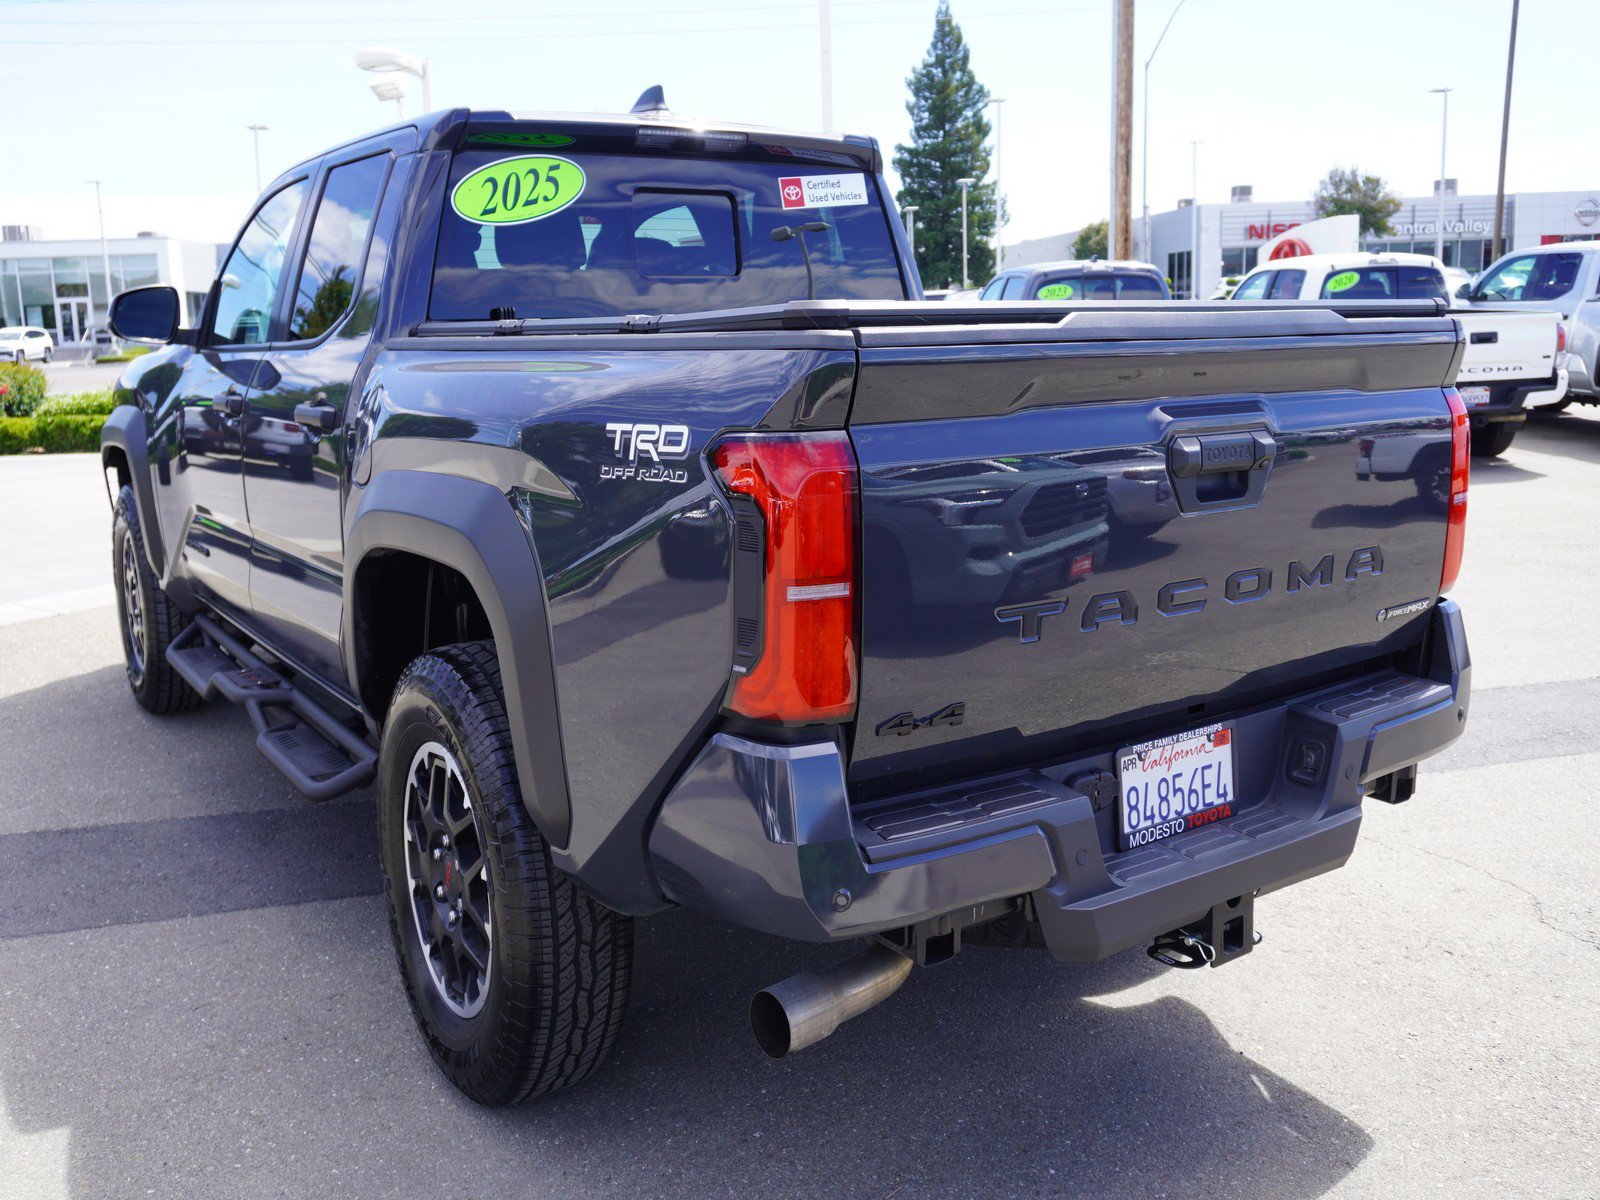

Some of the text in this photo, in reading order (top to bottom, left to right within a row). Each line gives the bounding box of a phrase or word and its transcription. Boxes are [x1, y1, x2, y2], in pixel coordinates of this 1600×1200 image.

[480, 163, 561, 216] 2025
[807, 178, 841, 190] Certified
[809, 191, 862, 203] Used Vehicles
[1390, 219, 1491, 236] entral Valley
[1044, 286, 1068, 299] 2023
[1332, 271, 1355, 290] 2020
[605, 422, 690, 463] TRD
[1203, 444, 1253, 463] TOYOTA
[599, 464, 688, 484] OFF ROAD
[994, 544, 1385, 645] TACOMA
[874, 701, 965, 737] 4x4
[1132, 723, 1223, 754] PRICE FAMILY DEALERSHIPS
[1121, 757, 1137, 773] APR
[1141, 741, 1214, 773] California
[1126, 760, 1229, 830] 84856E4
[1129, 804, 1232, 848] MODESTO TOYOTA
